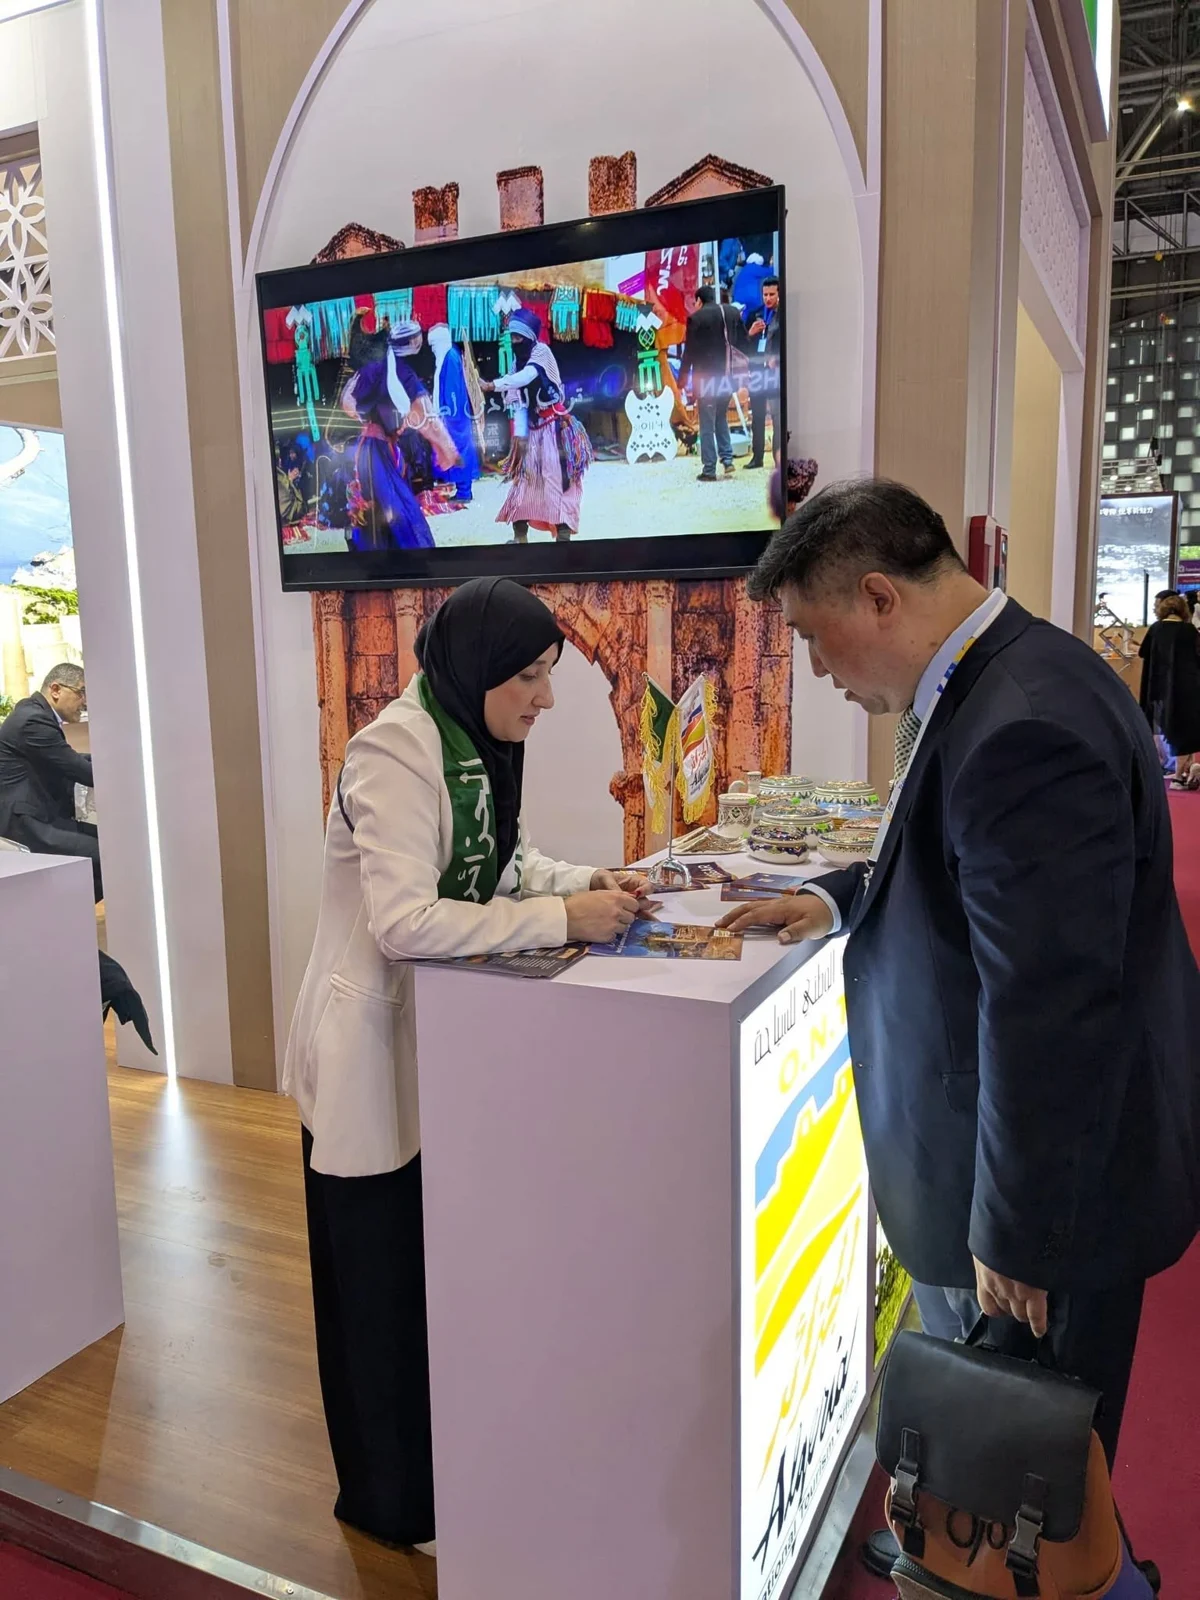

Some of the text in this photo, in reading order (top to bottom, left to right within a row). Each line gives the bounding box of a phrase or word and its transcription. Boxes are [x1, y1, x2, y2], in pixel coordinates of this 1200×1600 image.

[752, 1306, 860, 1575] Algeria
[761, 1519, 798, 1600] ational
[800, 1436, 835, 1519] Tourism
